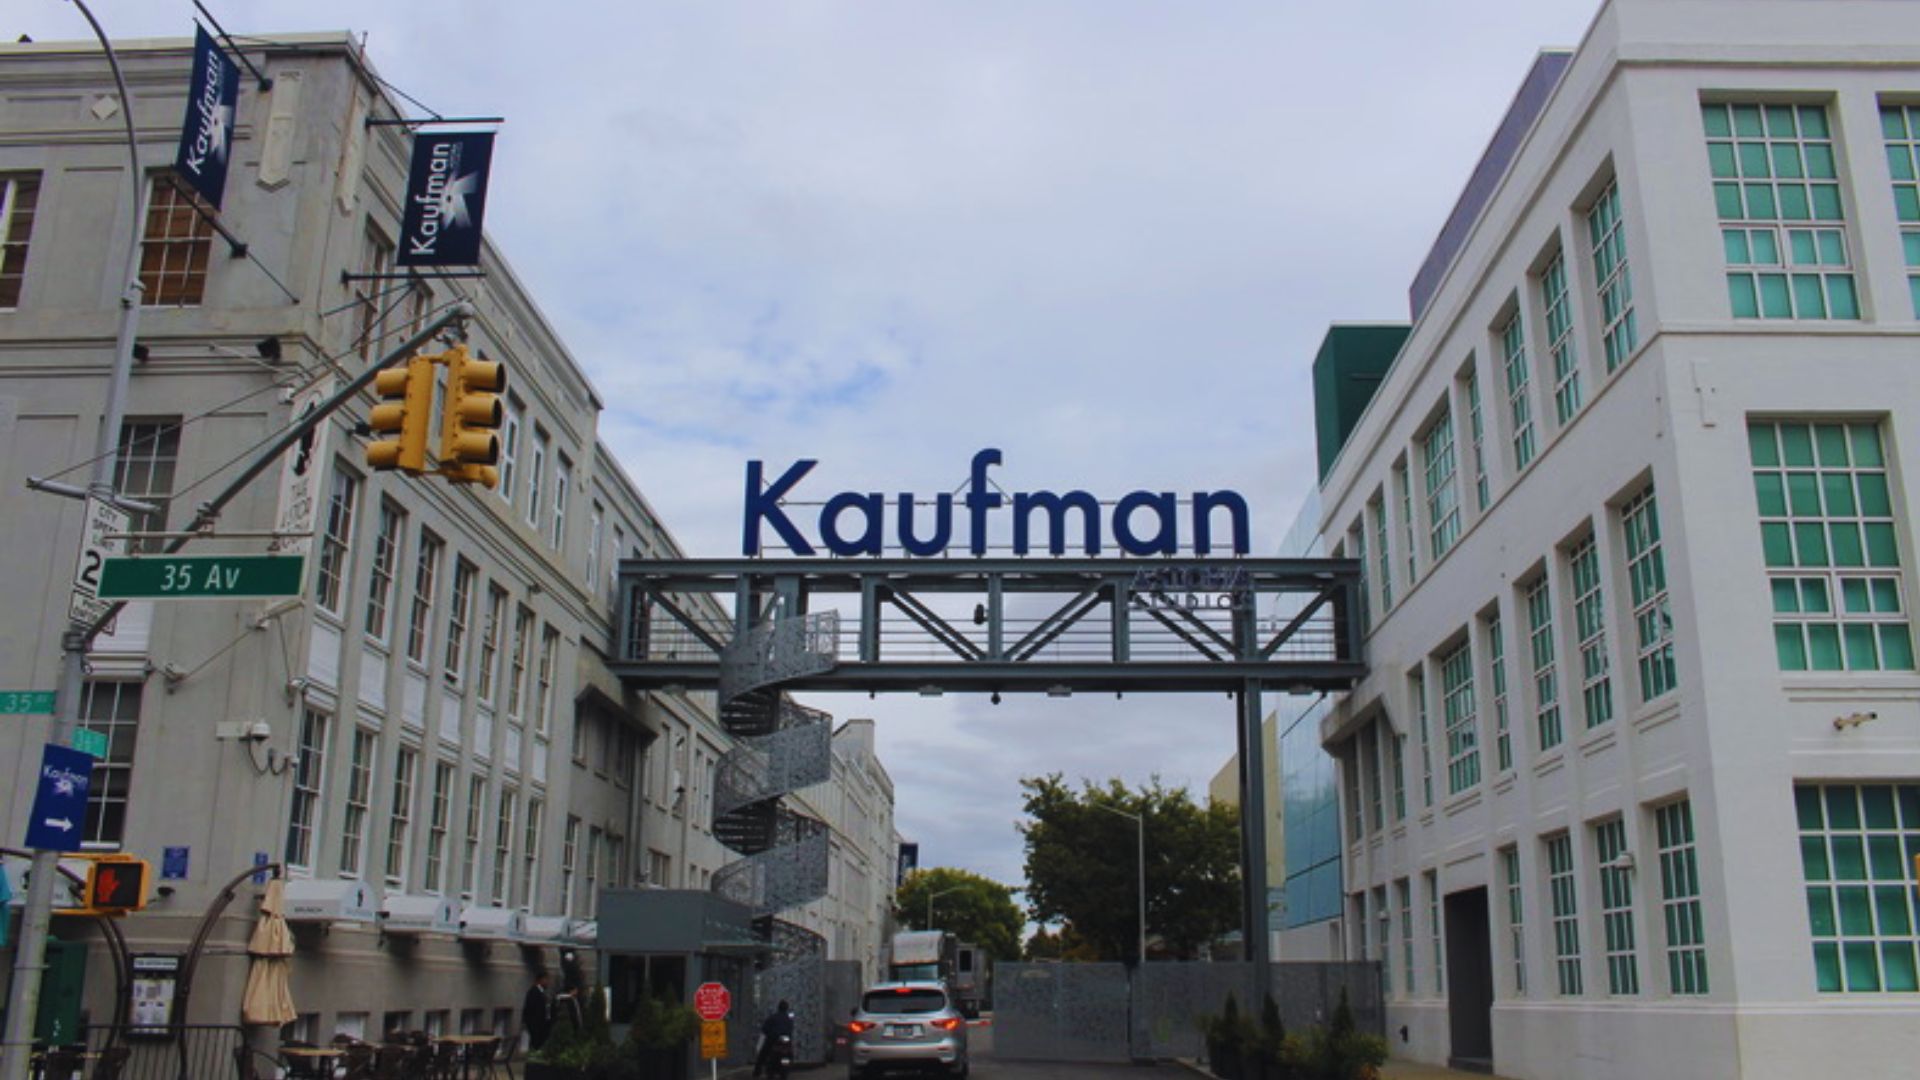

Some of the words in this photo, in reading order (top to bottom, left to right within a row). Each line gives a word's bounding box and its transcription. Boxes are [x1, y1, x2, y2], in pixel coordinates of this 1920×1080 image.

[186, 49, 220, 175] Kaufman
[410, 142, 450, 255] Kaufman
[742, 448, 1250, 556] Kaufman
[82, 549, 101, 585] 2
[160, 564, 193, 591] 35
[5, 694, 32, 712] 35
[43, 764, 88, 785] Kaufman
